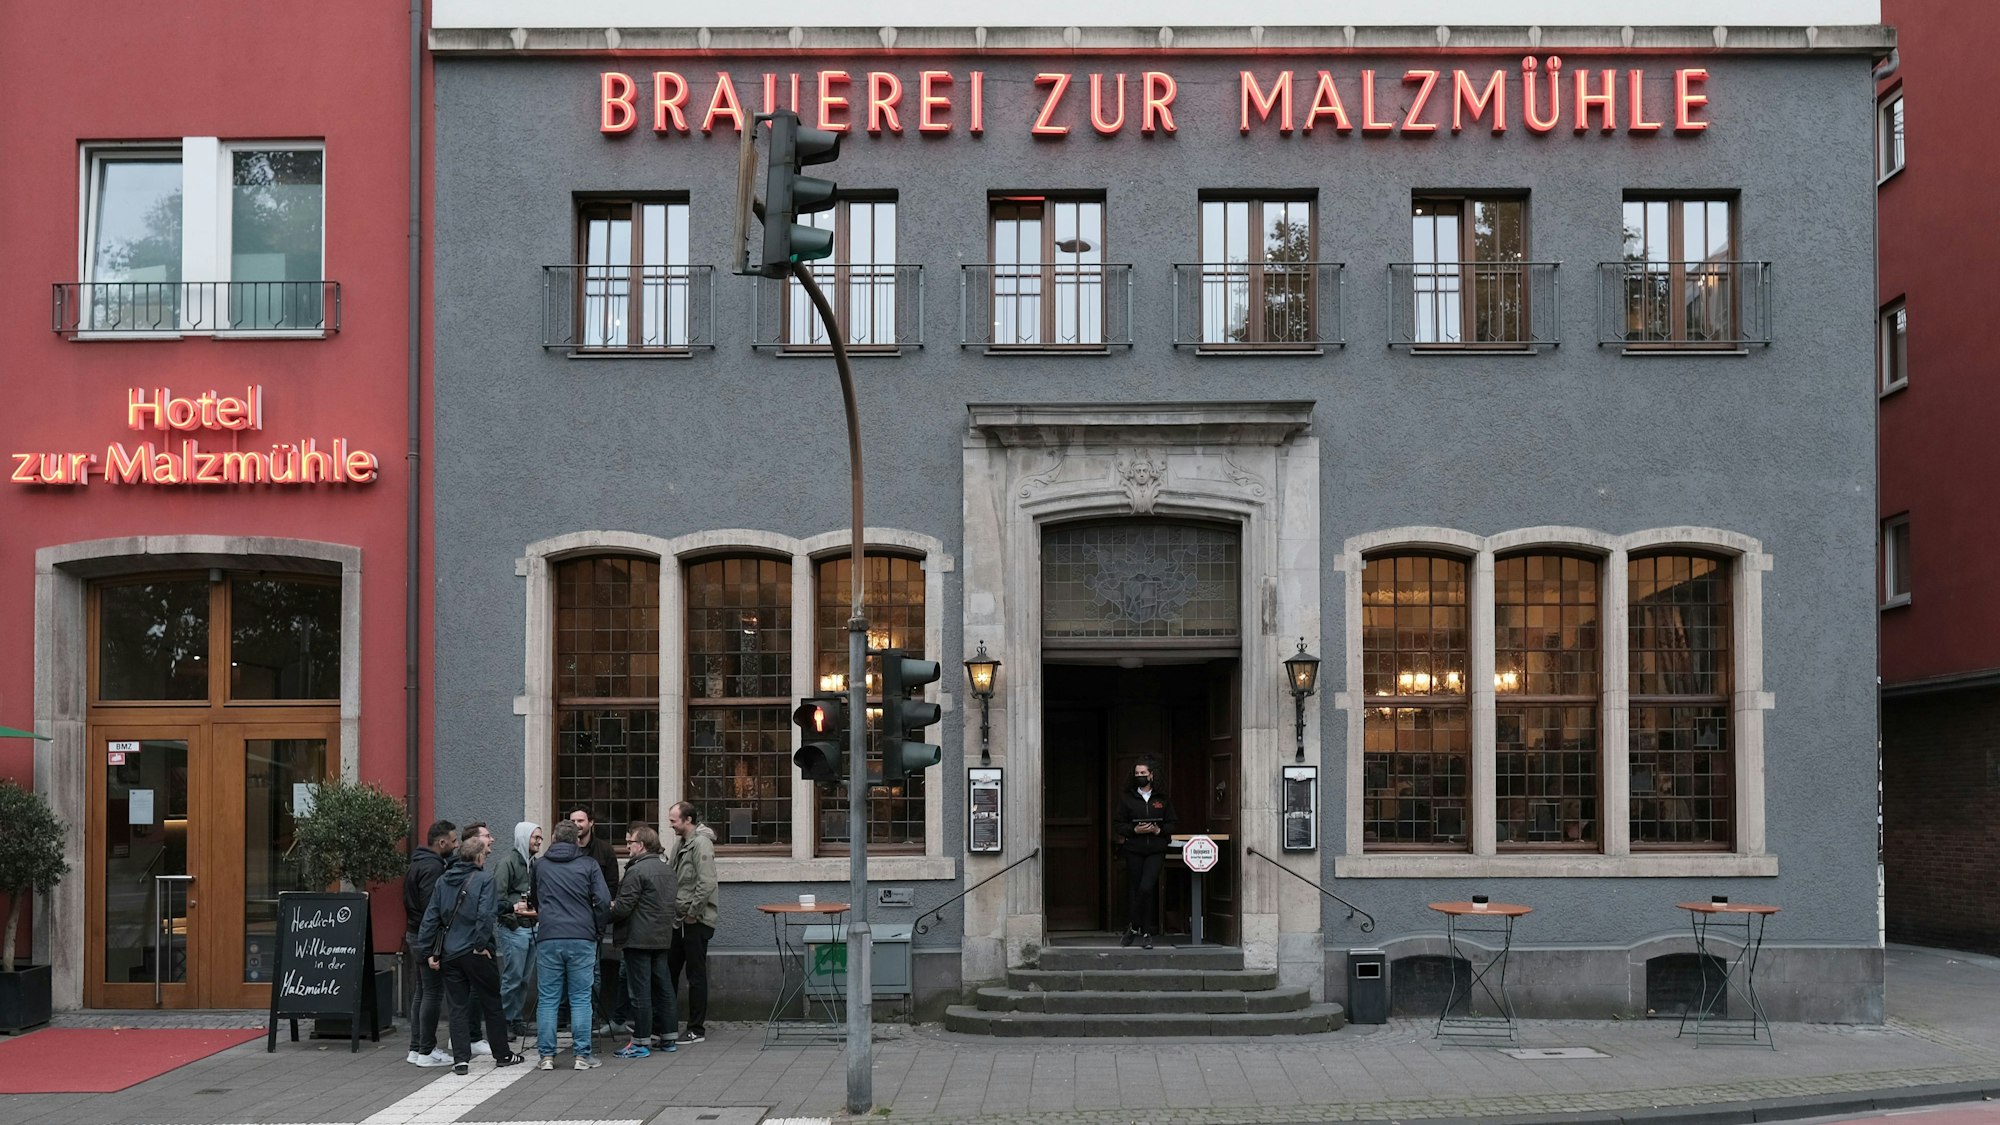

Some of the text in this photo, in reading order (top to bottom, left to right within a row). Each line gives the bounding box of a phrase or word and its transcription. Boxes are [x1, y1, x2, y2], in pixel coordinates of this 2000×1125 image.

[600, 55, 1711, 135] BRAUEREI ZUR MALZMÜHLE
[128, 384, 263, 431] Hotel
[11, 437, 379, 486] zur Malzmühle
[291, 905, 335, 933] Herzlich
[295, 937, 357, 958] Willkommen
[314, 956, 346, 970] in der
[280, 969, 341, 997] Malzmühle
